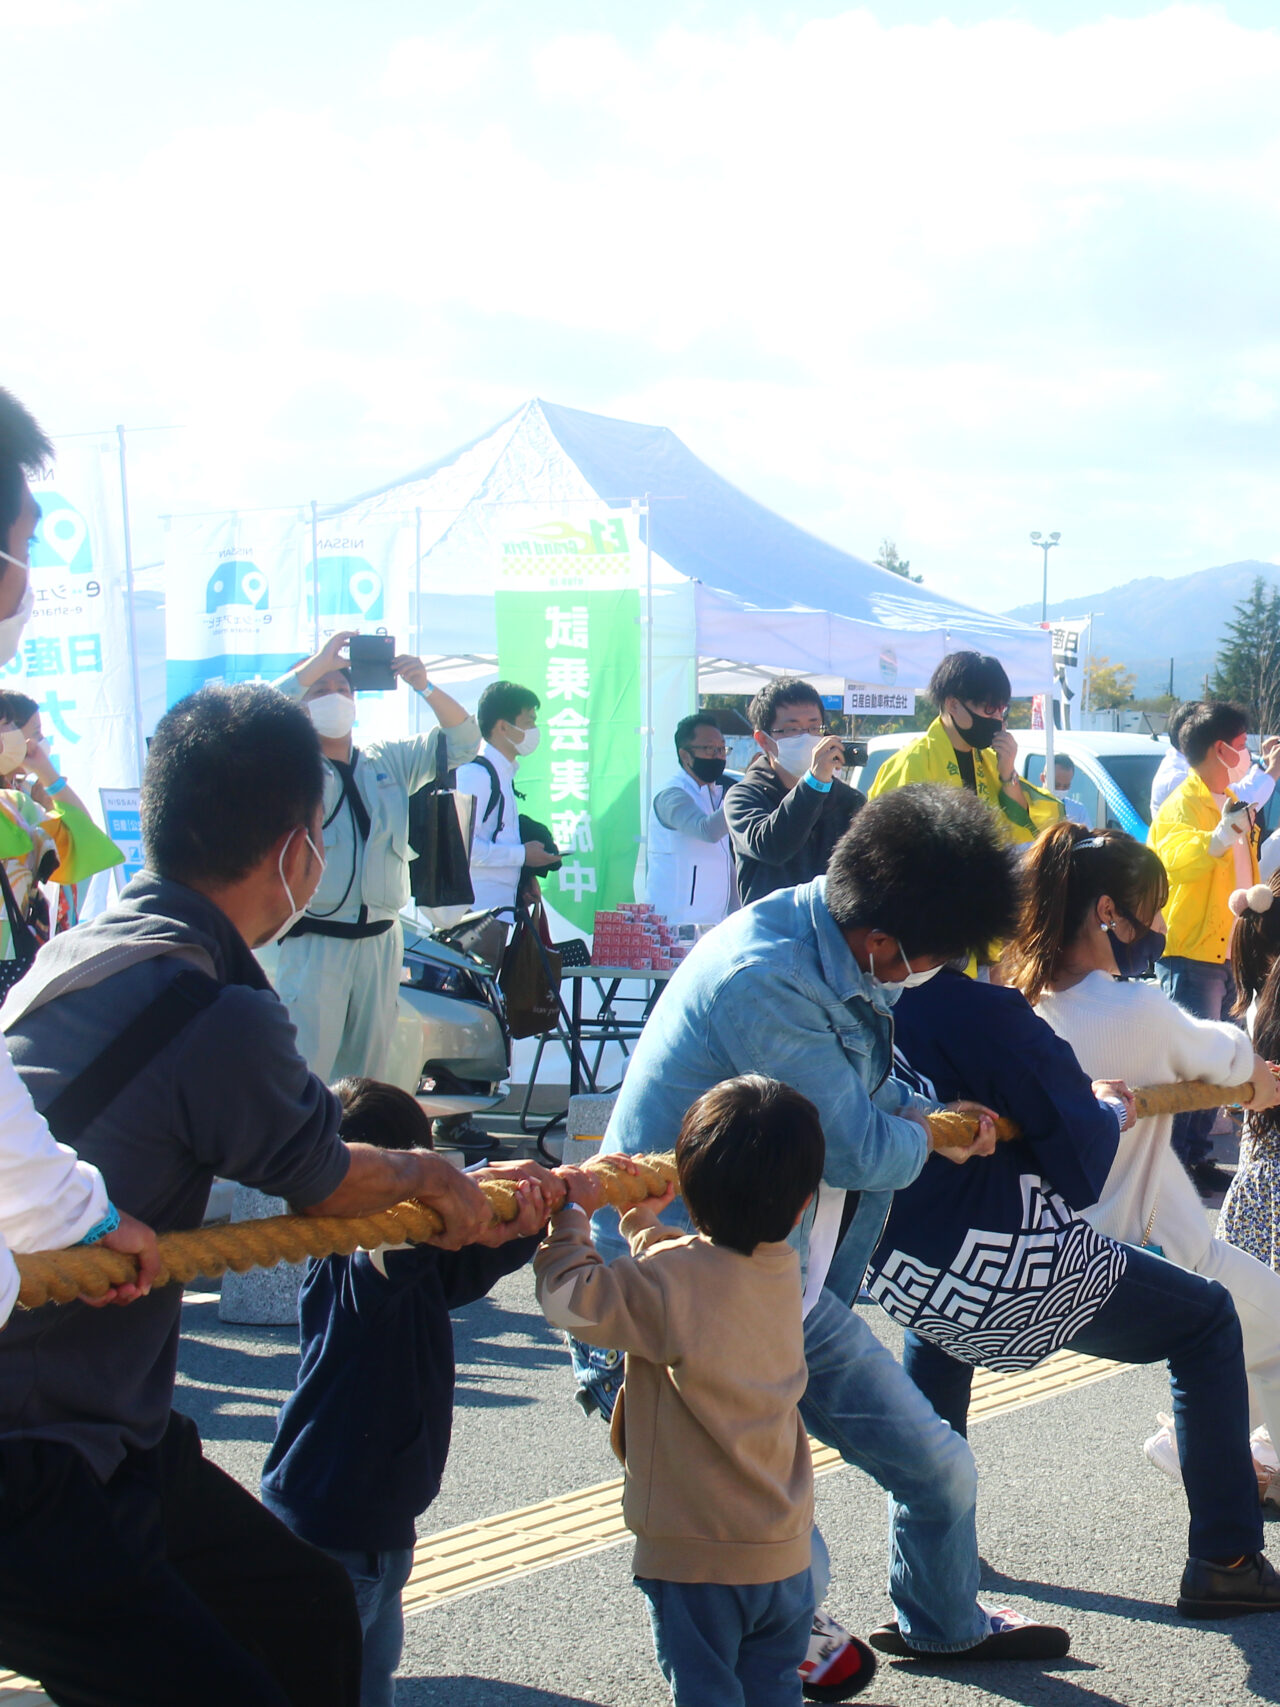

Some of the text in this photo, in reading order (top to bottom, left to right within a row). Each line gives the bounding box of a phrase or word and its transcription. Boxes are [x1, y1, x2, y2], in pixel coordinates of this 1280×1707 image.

[852, 693, 908, 709] 日産自動車株式会社
